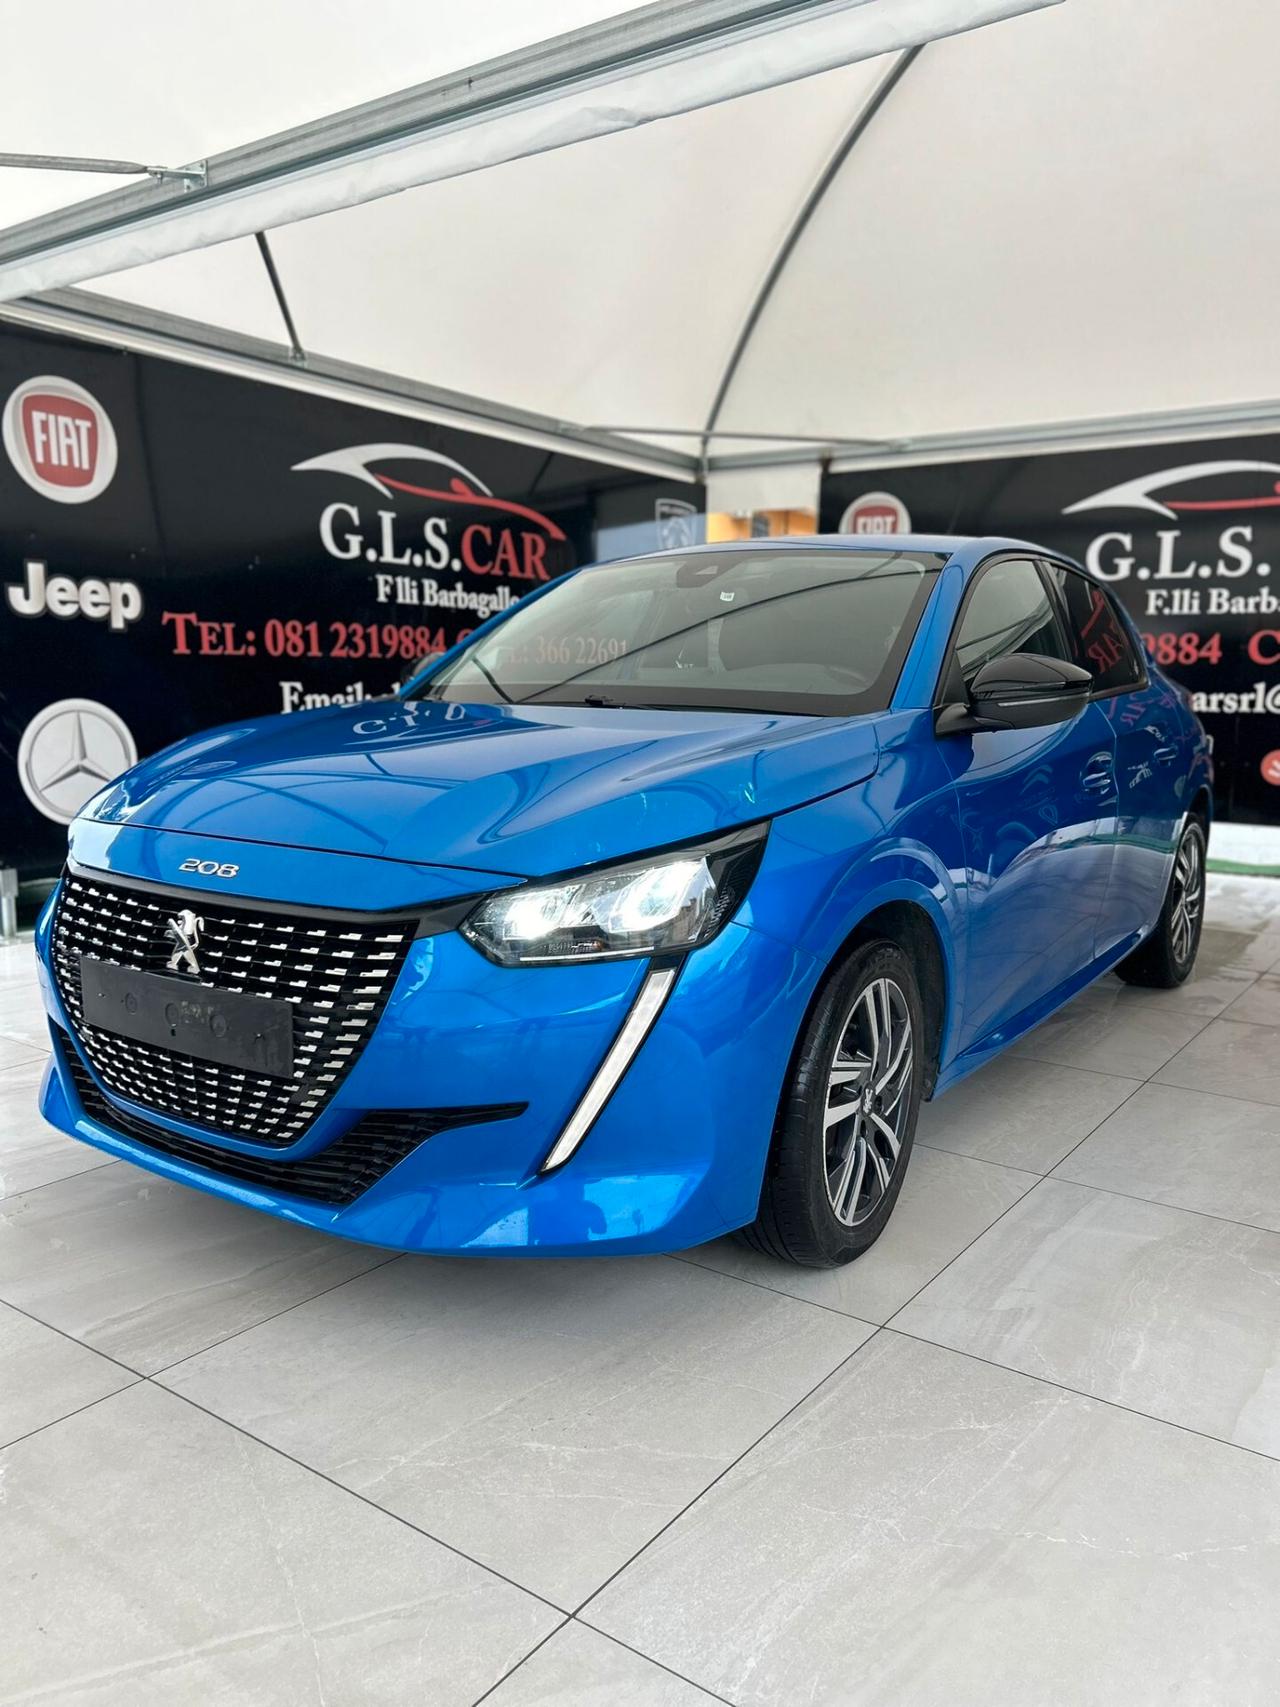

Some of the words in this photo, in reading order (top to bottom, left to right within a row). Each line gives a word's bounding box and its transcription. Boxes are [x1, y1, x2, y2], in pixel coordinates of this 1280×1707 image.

[31, 411, 92, 470] FIAT
[1086, 525, 1272, 581] G.L.S.
[8, 562, 142, 630] Jeep
[1145, 588, 1201, 615] F.lli
[1206, 586, 1280, 615] Barb
[162, 611, 257, 657] TEL:
[264, 618, 321, 657] 081
[330, 623, 447, 660] 2319884
[178, 858, 239, 878] 208
